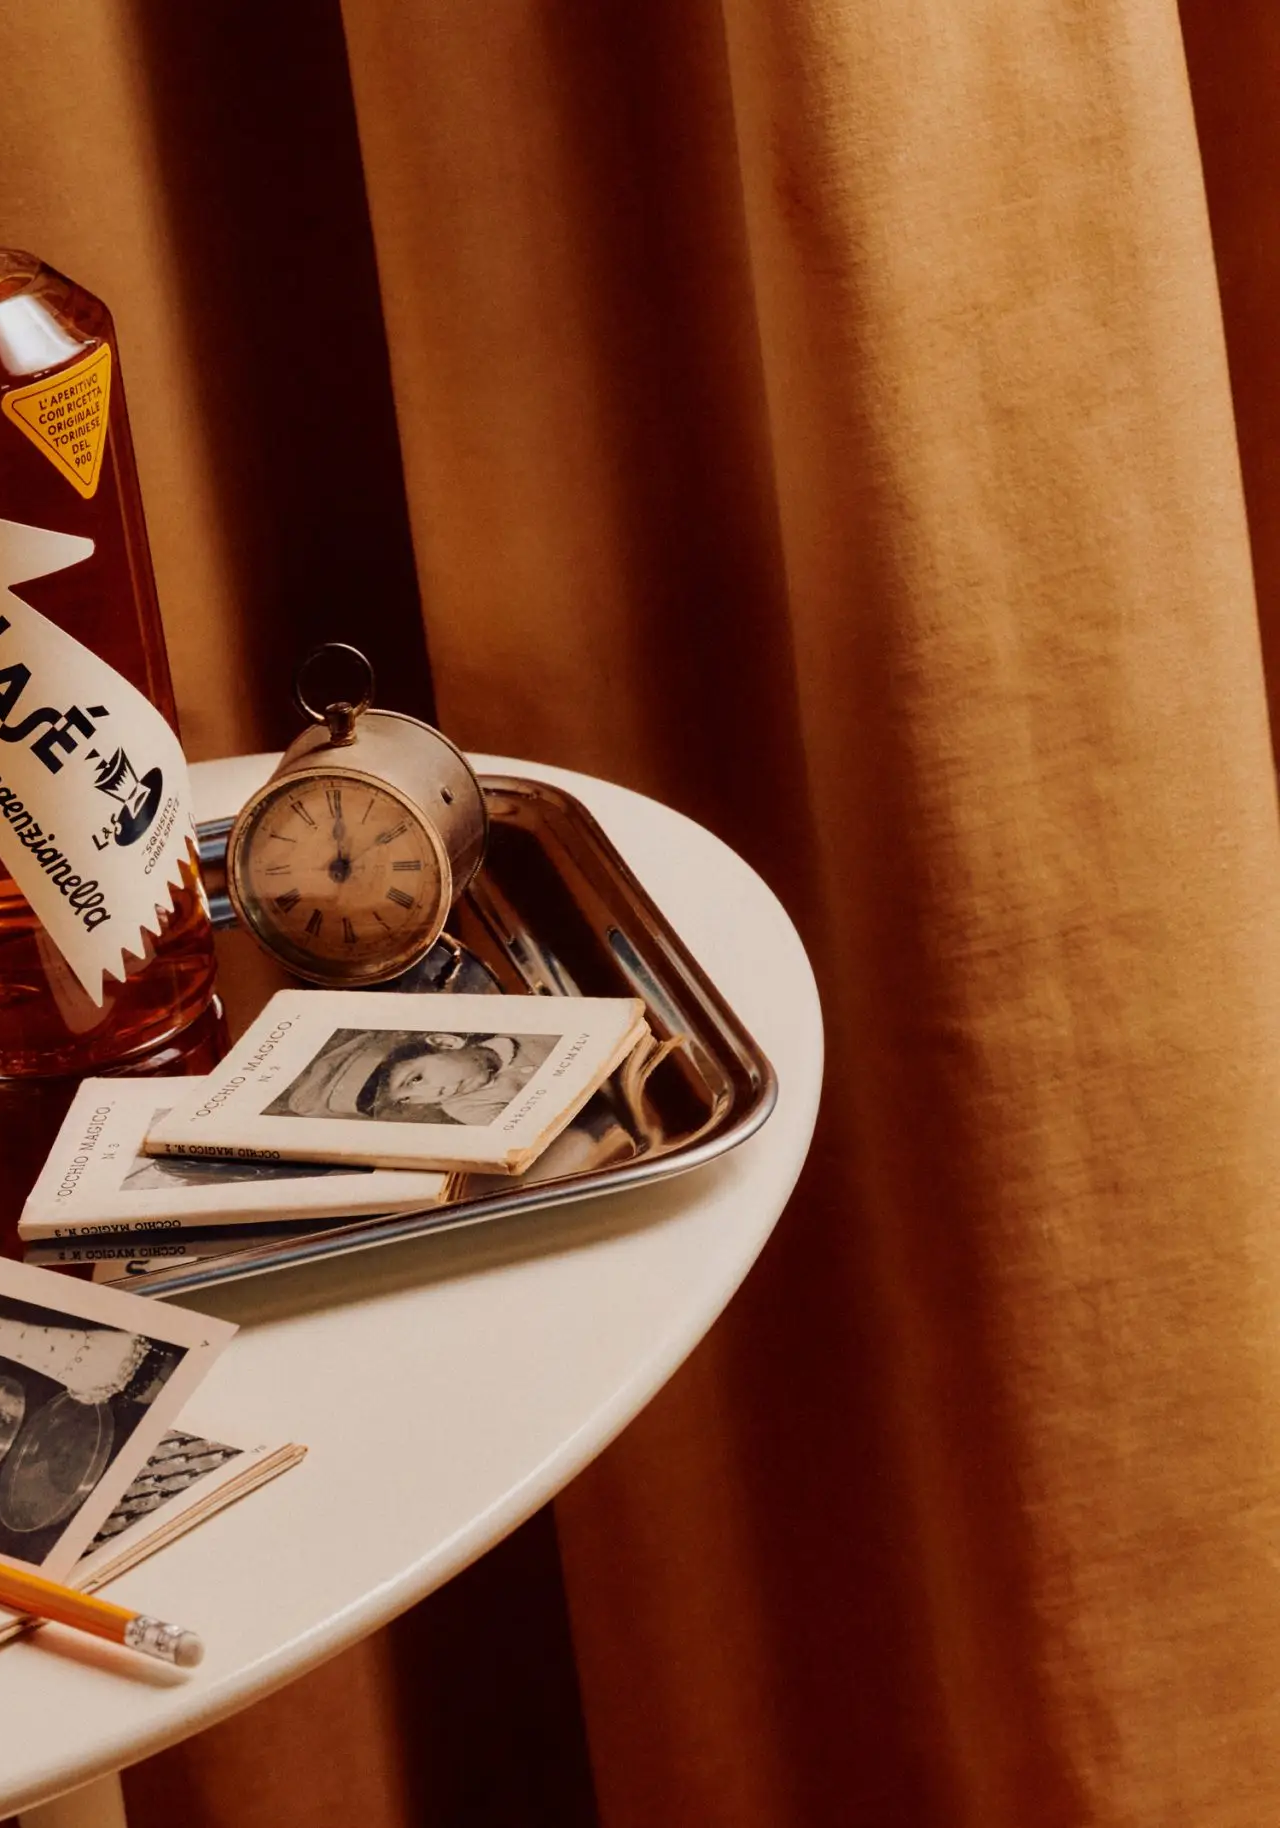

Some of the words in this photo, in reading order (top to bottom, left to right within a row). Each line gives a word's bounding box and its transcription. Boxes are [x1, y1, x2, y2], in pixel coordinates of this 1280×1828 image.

[38, 373, 99, 411] L'APERITIVO
[38, 408, 65, 425] CON
[67, 385, 102, 413] RICETTA
[47, 402, 100, 436] ORIGINALE
[53, 416, 101, 447] TORINESE
[72, 439, 91, 455] DEL
[74, 451, 93, 468] 900
[188, 1145, 234, 1157] MAGICO
[238, 1148, 280, 1160] OCCHIO
[81, 1223, 129, 1235] MAGICO
[135, 1220, 181, 1231] OCCHIO
